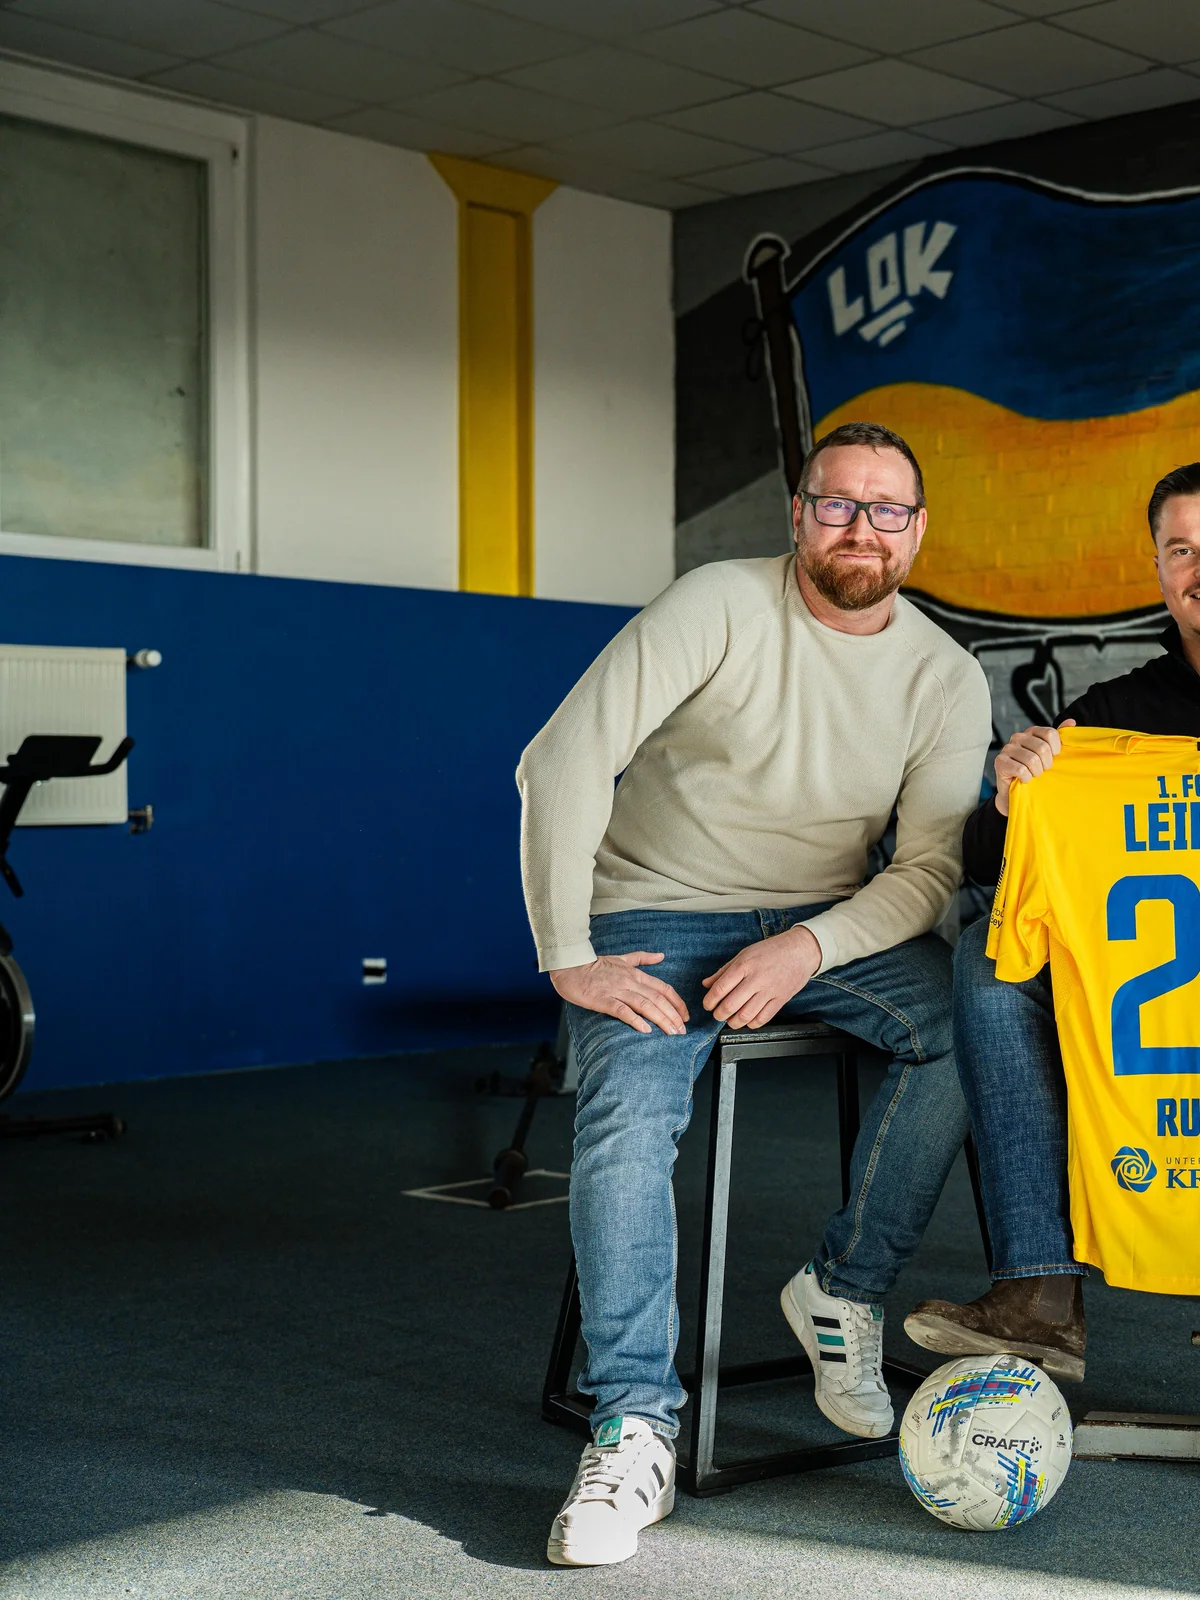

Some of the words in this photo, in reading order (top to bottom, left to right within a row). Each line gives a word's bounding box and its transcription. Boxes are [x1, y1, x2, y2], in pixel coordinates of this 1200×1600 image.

[827, 220, 957, 336] LOK
[1157, 774, 1178, 799] 1.
[972, 1433, 1030, 1452] CRAFT
